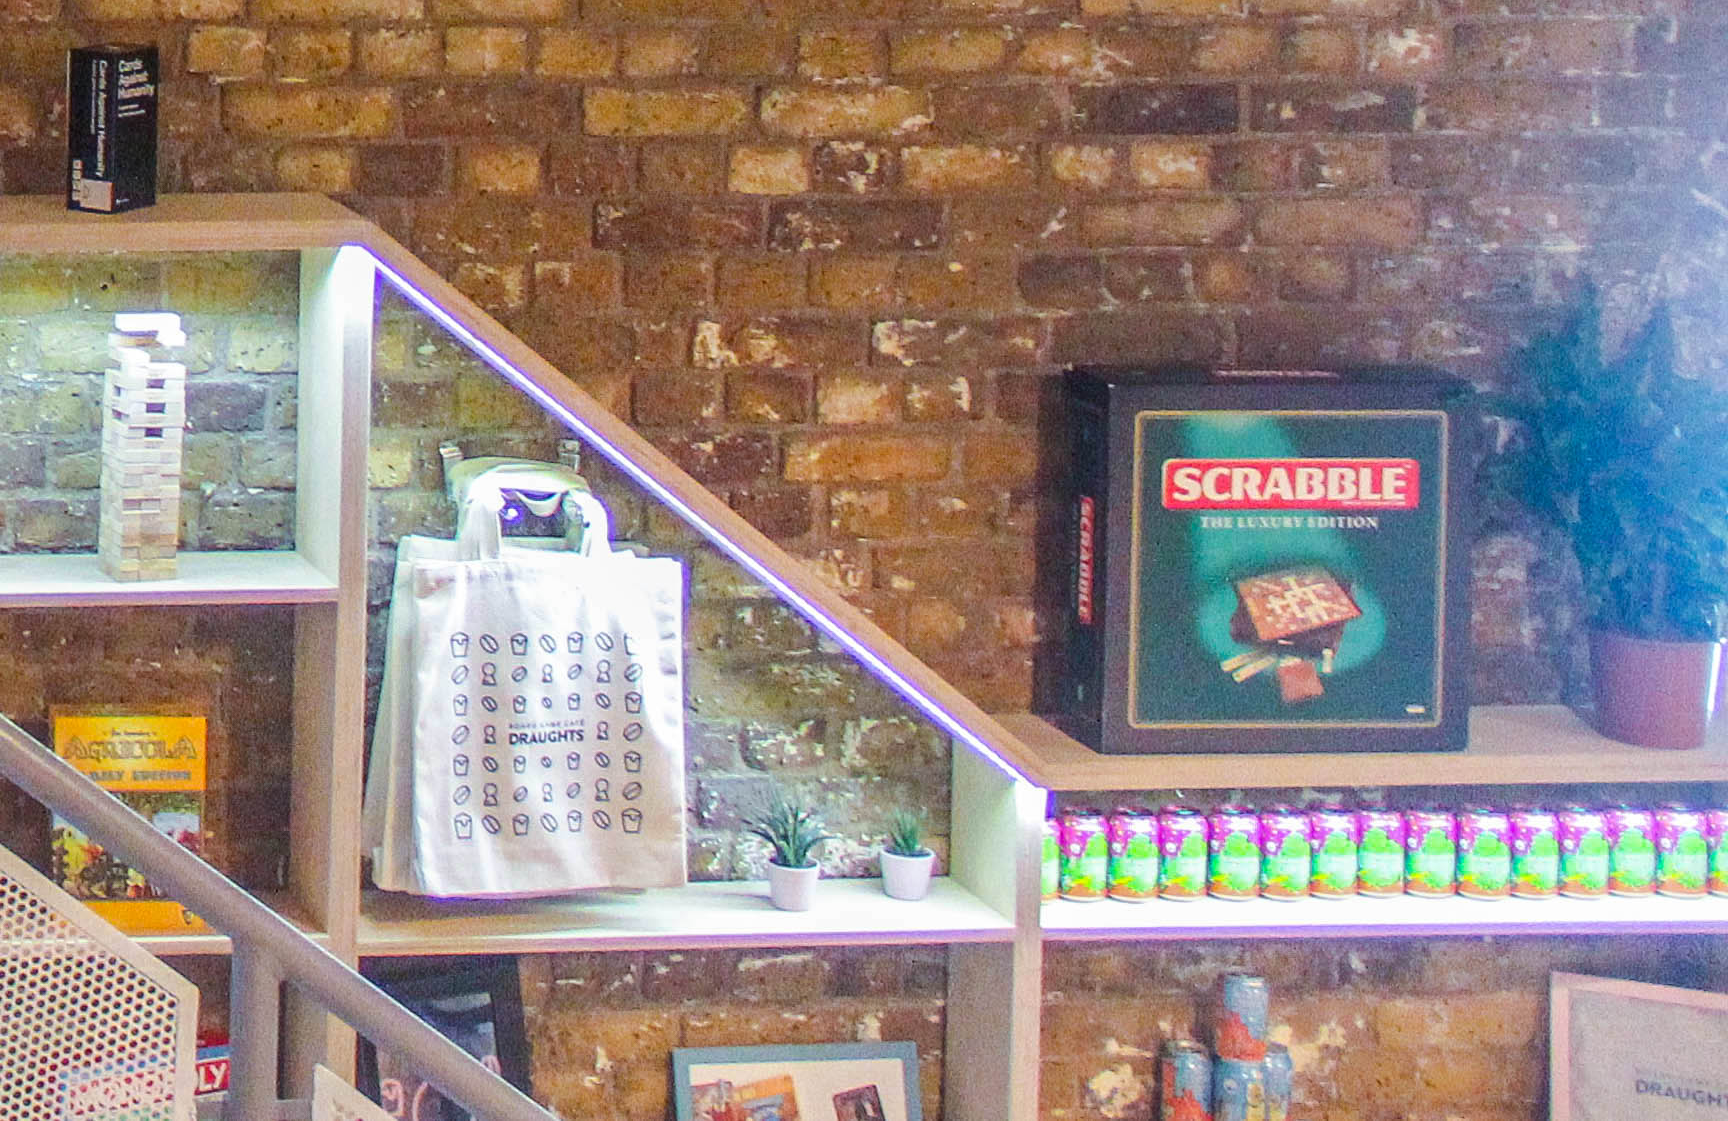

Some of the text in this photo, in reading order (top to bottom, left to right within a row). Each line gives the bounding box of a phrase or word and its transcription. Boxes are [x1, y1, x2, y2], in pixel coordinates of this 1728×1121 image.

[1172, 465, 1407, 503] SCRABBLE
[1200, 516, 1380, 531] THE LUXURY EDITION
[508, 729, 585, 745] DRAUGHTS
